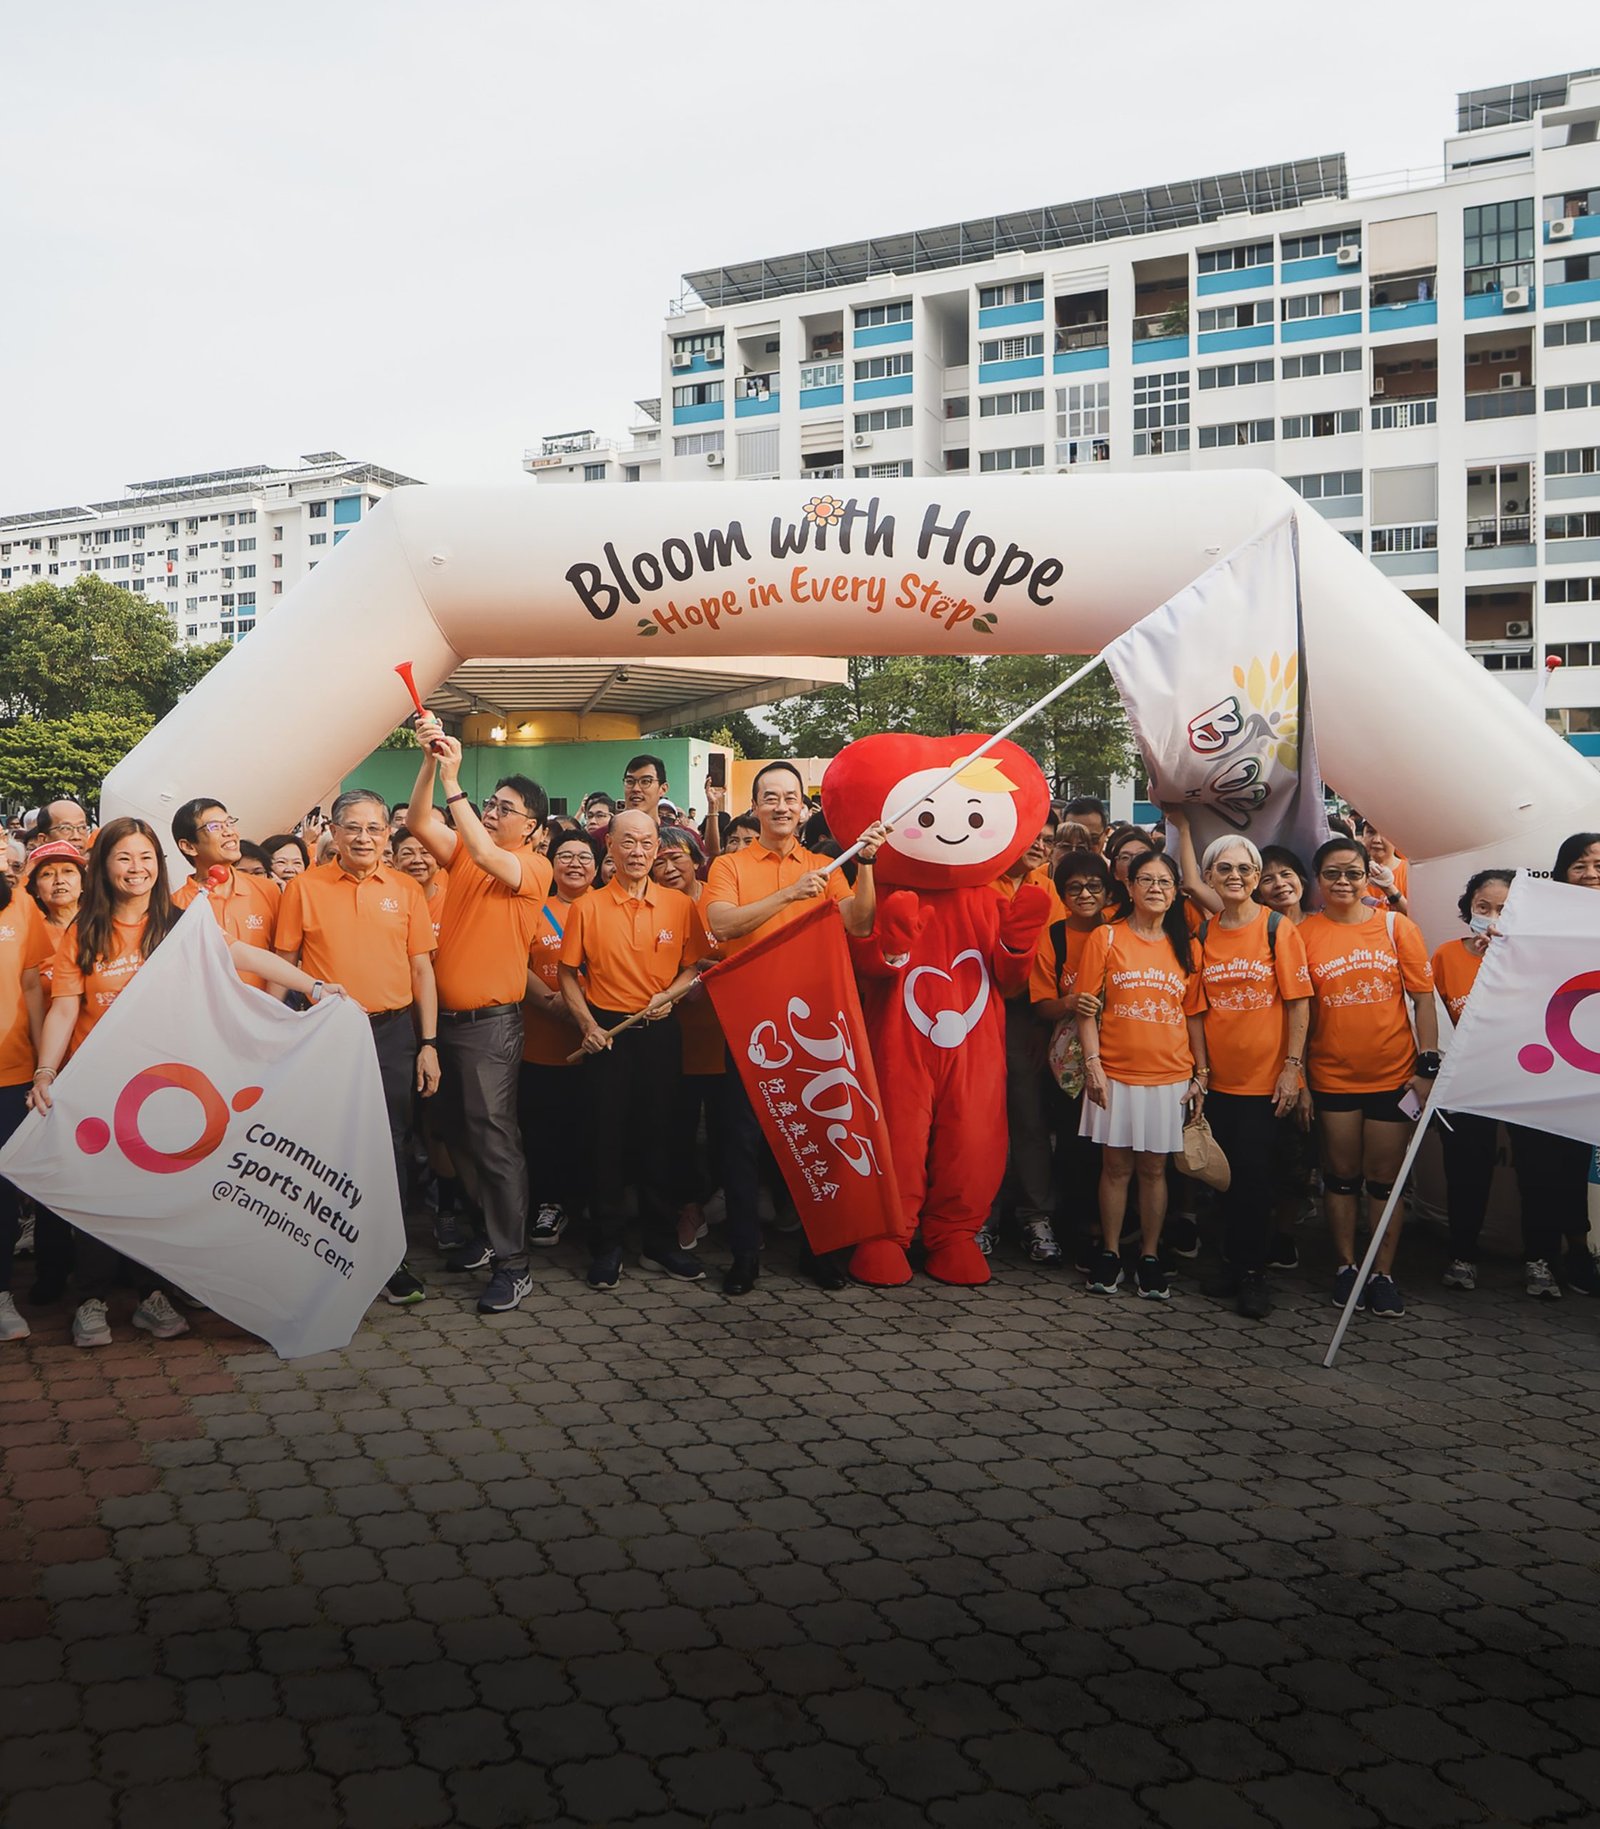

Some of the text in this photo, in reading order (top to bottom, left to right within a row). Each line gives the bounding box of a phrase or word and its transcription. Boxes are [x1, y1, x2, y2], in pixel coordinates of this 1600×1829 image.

[565, 496, 1064, 620] Bloom with Hope
[652, 566, 977, 635] Hope in Every Step
[1112, 970, 1141, 985] Bloom
[1143, 967, 1165, 981] with
[1228, 957, 1249, 971] with
[1314, 956, 1346, 977] Bloom
[1348, 948, 1372, 963] with
[1375, 949, 1398, 968] Hope
[1353, 961, 1372, 970] Every
[787, 996, 883, 1177] 365
[227, 1152, 302, 1201] Sports
[246, 1123, 362, 1209] Community
[758, 1081, 823, 1202] Cancer Prevention Society
[767, 1078, 840, 1199] 防癌教育协会
[212, 1180, 355, 1280] @Tampines Cent
